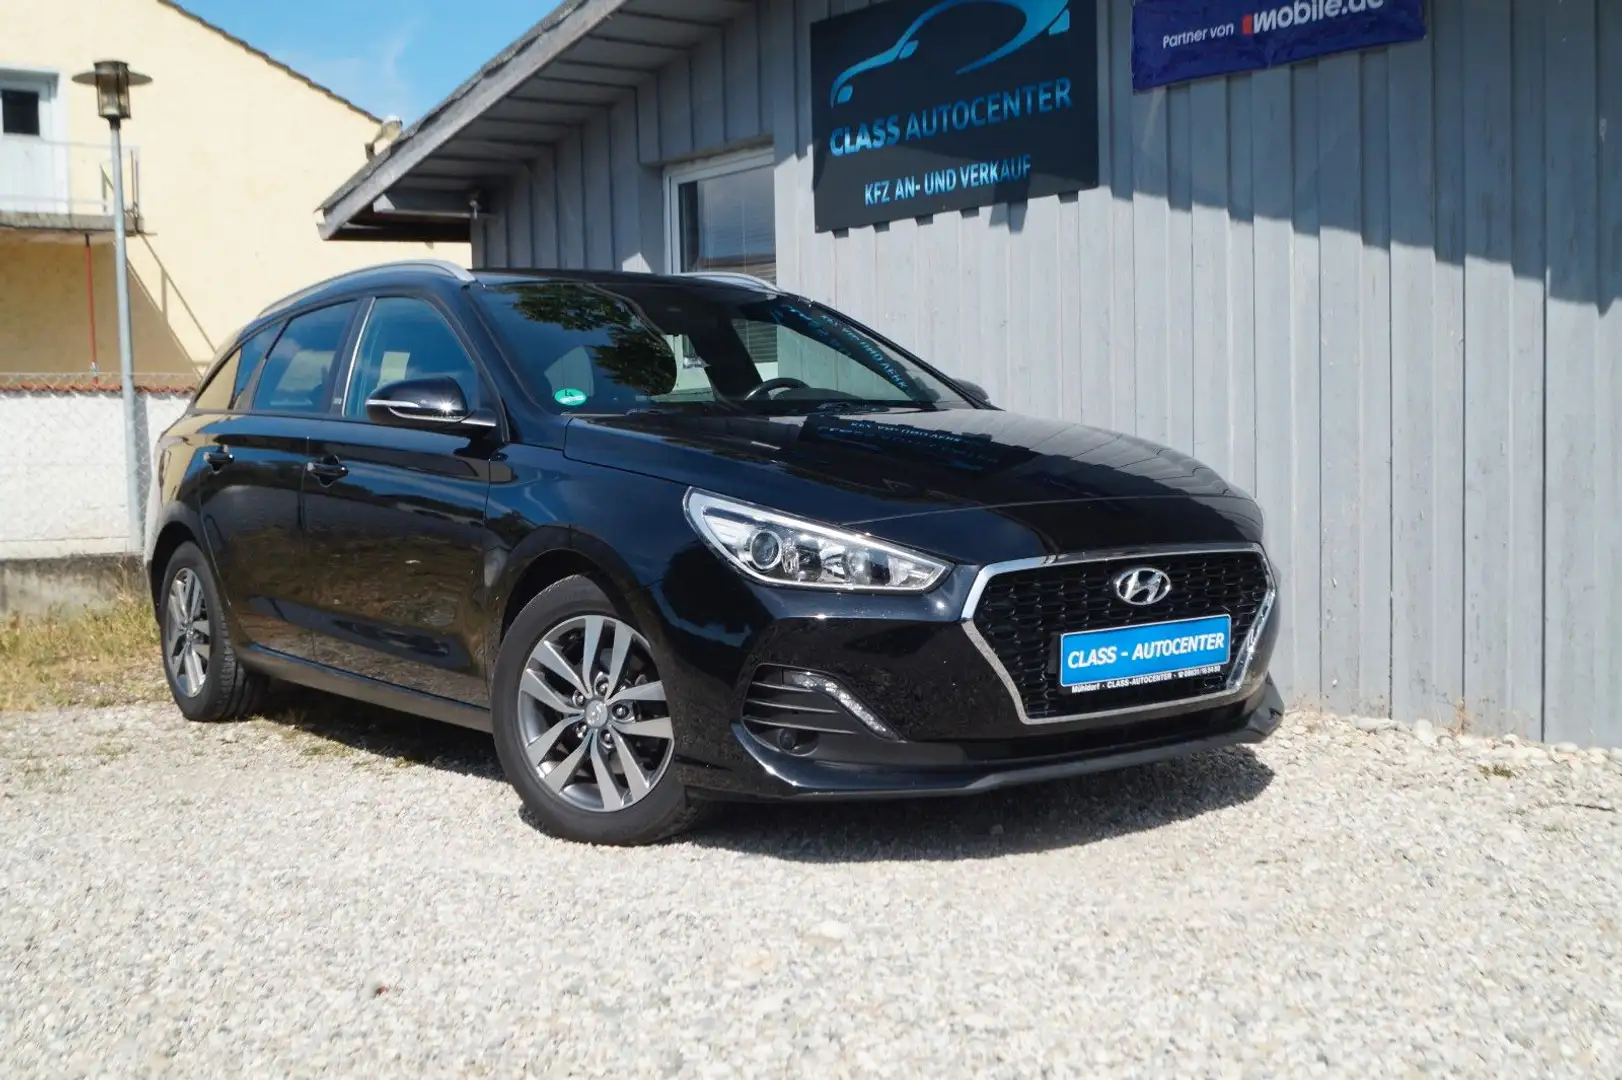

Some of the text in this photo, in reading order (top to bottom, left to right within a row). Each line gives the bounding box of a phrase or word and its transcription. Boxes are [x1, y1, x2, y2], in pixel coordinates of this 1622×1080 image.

[1163, 28, 1208, 49] Partner
[1210, 23, 1234, 39] von
[829, 76, 1073, 157] CLASS AUTOCENTER
[864, 153, 1031, 205] KFZ AN- UND VERKAUF
[1067, 646, 1118, 669] CLASS
[1132, 632, 1225, 661] AUTOCENTER
[1071, 682, 1100, 694] Mühldorf
[1106, 672, 1172, 689] CLASS-AUTOCENTER
